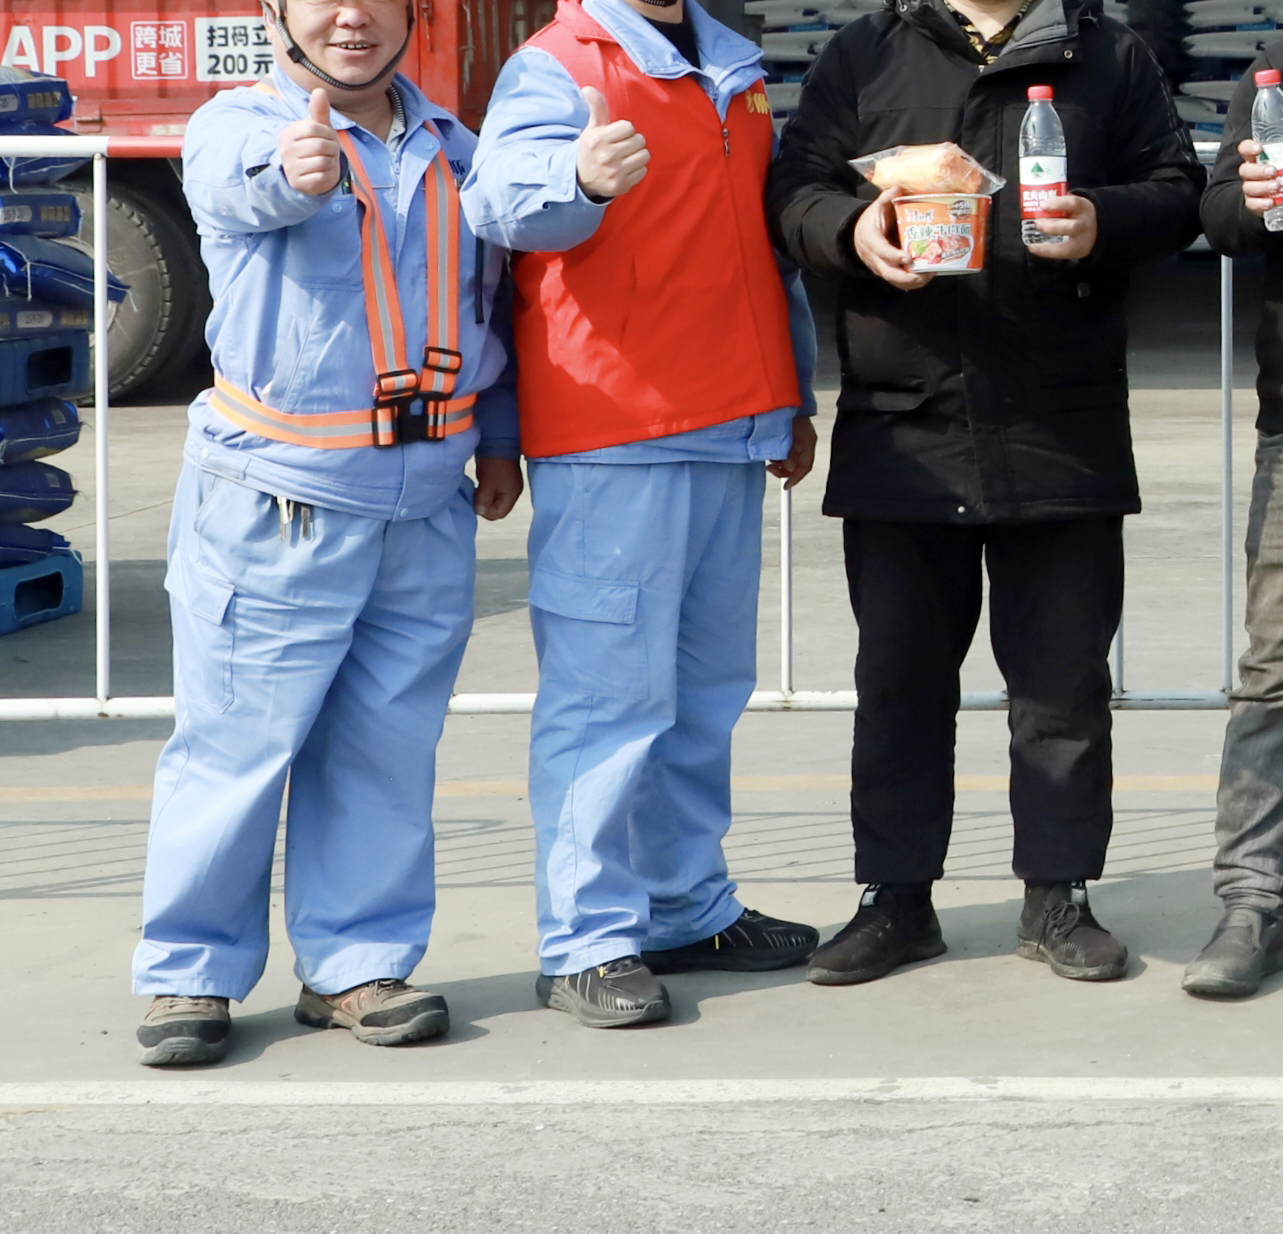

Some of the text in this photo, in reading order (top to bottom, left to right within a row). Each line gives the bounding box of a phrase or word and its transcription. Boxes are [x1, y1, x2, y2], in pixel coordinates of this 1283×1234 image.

[135, 26, 183, 49] 跨城
[207, 25, 274, 48] 扫码立
[2, 26, 122, 77] APP
[135, 52, 182, 76] 更省
[906, 222, 971, 241] 香辣牛肉面
